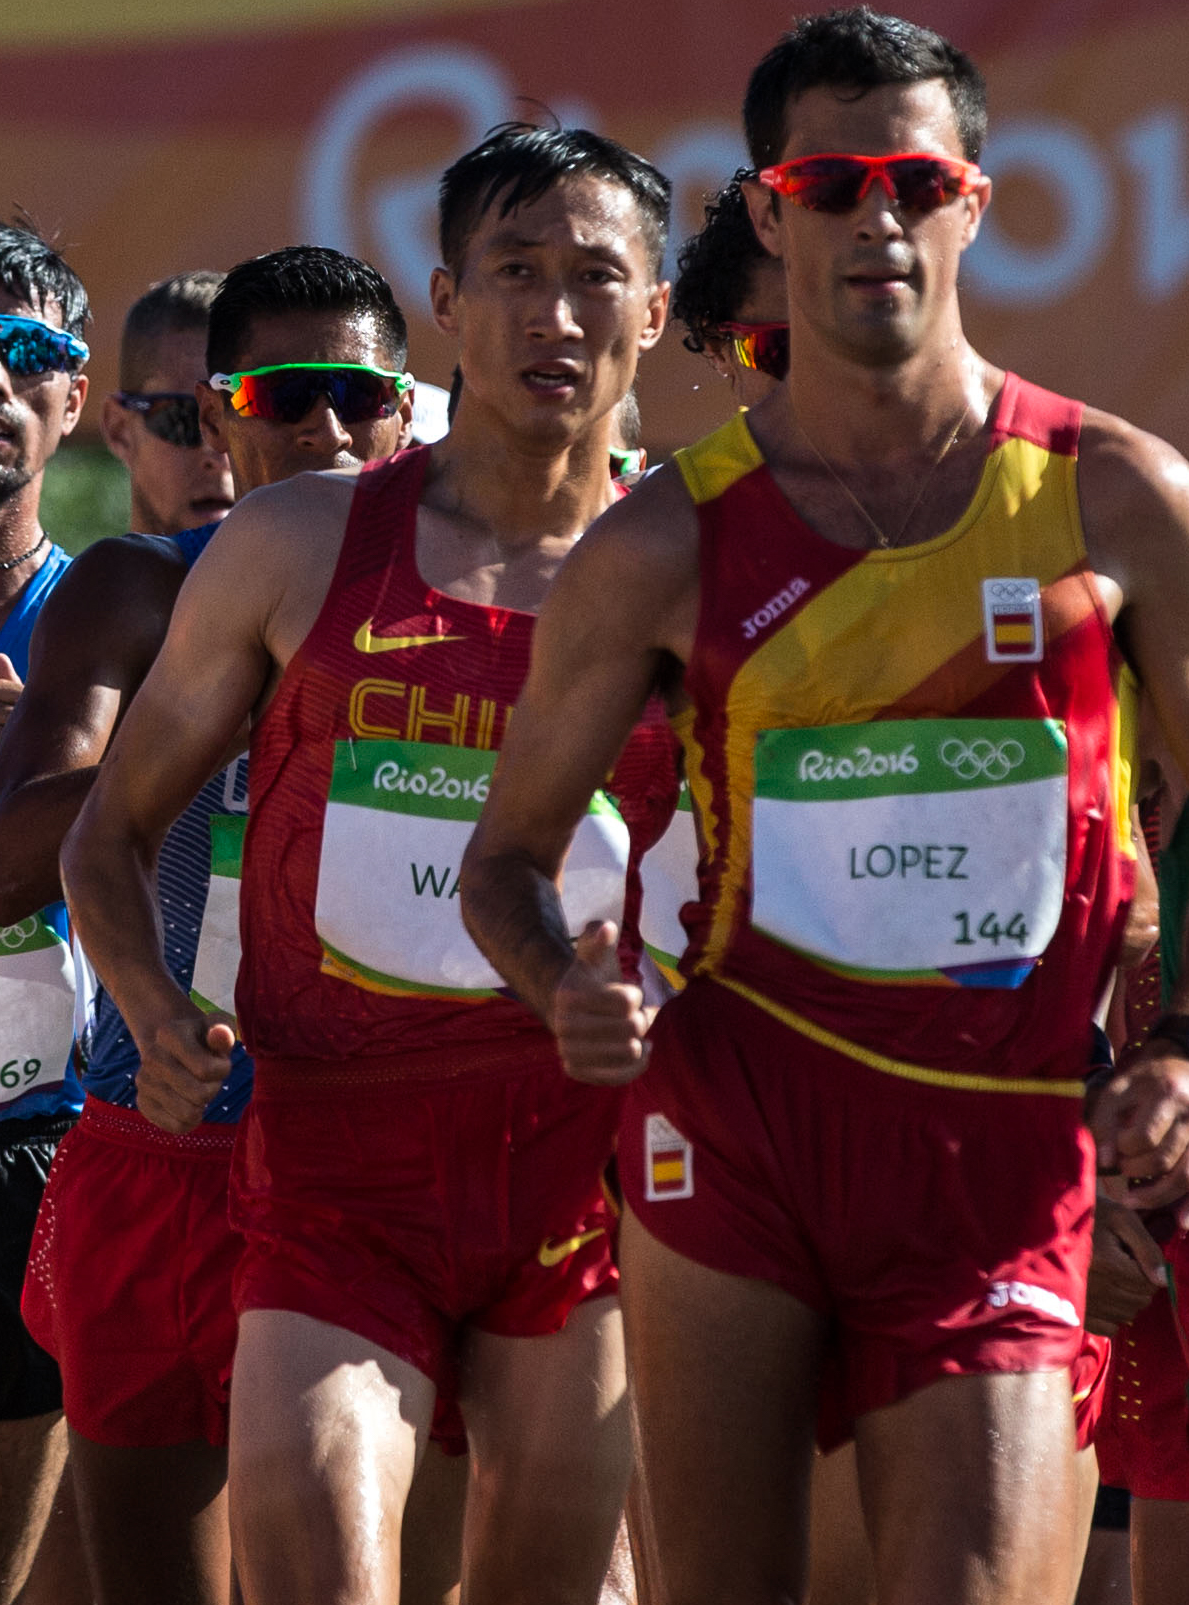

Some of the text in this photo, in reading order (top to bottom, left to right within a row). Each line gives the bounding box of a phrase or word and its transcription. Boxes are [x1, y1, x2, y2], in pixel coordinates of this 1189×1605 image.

[349, 677, 514, 750] CHI
[373, 760, 490, 803] Rio2016
[799, 745, 919, 782] Rio2016
[850, 844, 969, 880] LOPEZ
[954, 911, 1031, 946] 144
